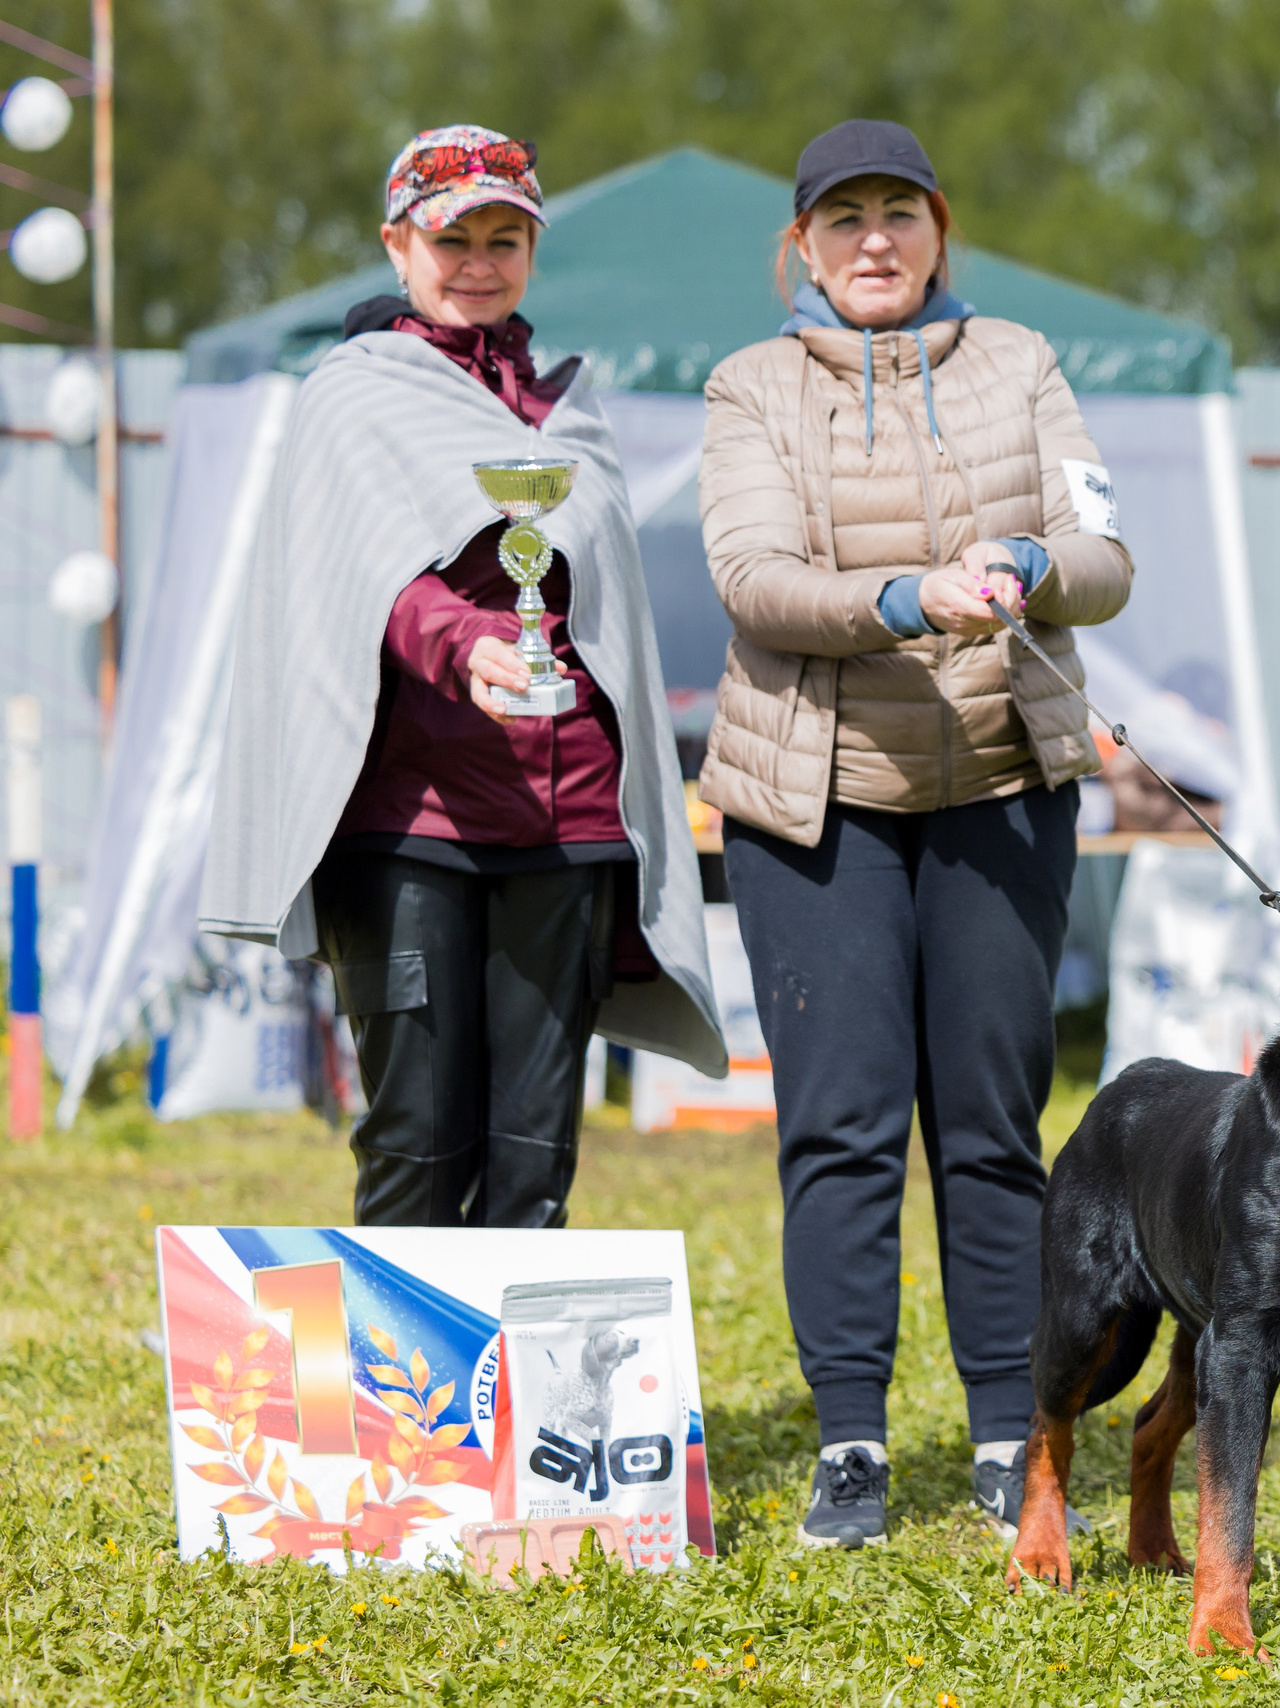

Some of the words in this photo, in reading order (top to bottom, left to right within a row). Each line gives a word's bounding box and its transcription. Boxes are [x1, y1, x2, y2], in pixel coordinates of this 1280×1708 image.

[251, 1257, 360, 1455] 1
[477, 1342, 500, 1420] РОТВЕ
[554, 1498, 570, 1506] LINE
